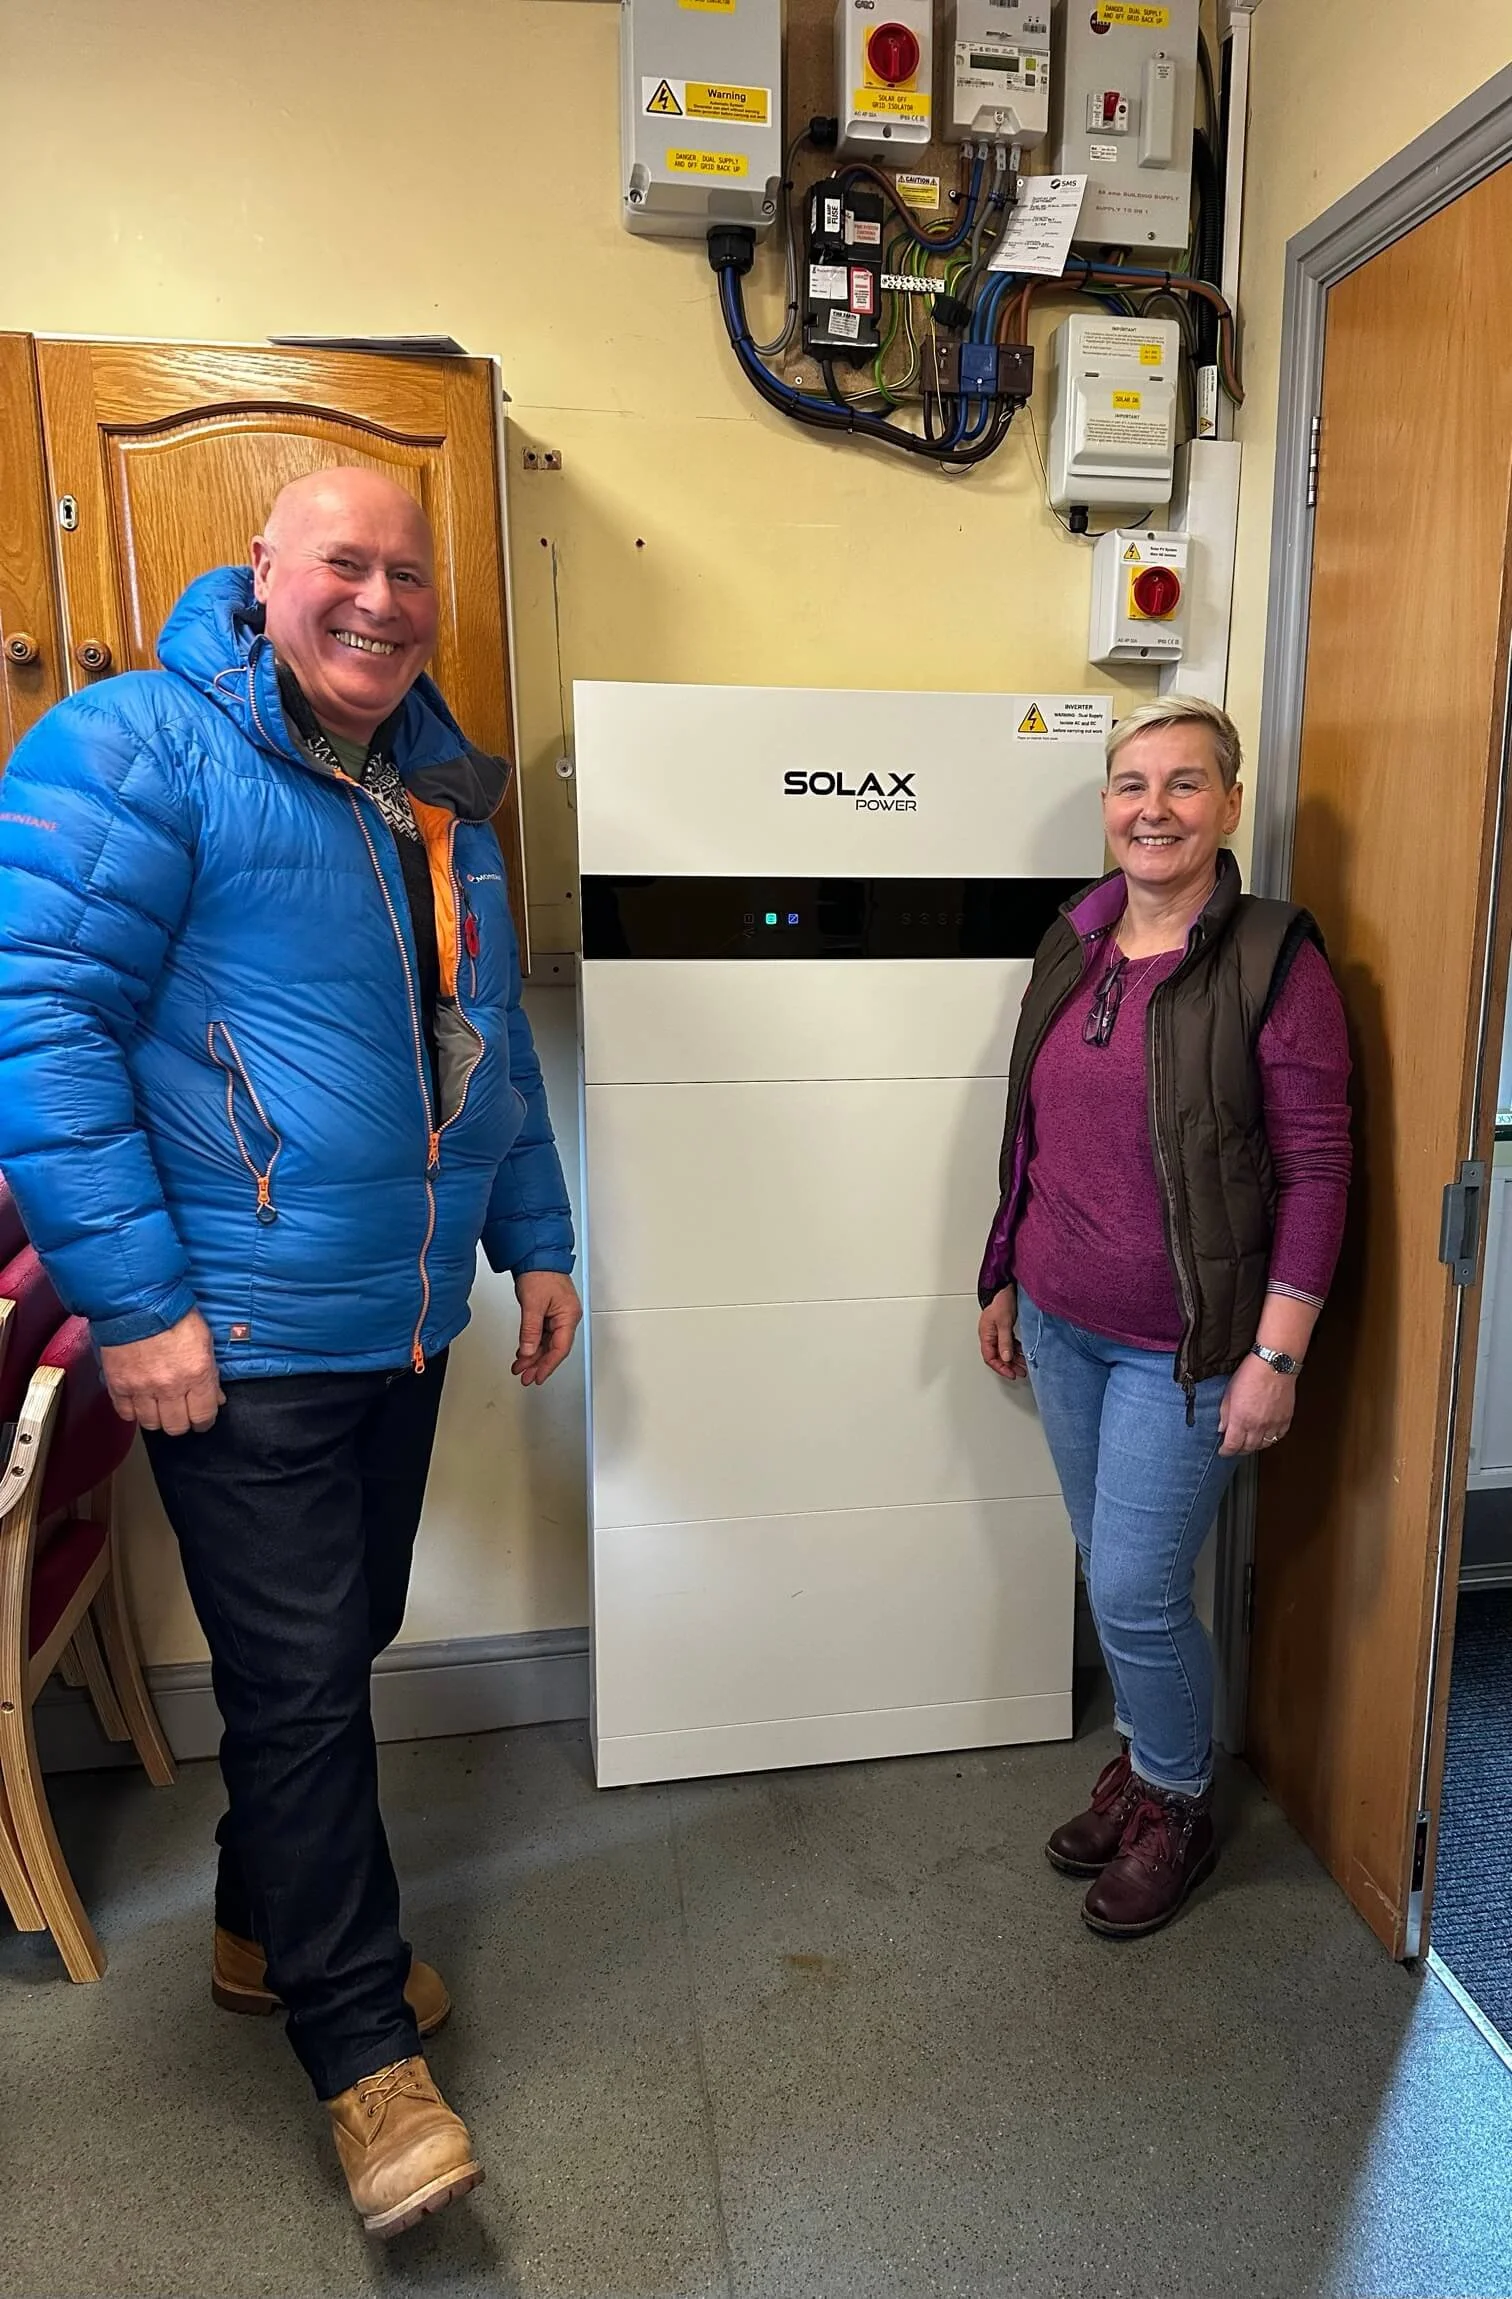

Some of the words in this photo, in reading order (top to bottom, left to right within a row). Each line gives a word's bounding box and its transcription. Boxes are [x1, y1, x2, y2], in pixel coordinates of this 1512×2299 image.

[1144, 9, 1161, 17] SUPPLY
[708, 88, 746, 103] Warning
[897, 95, 907, 103] OFF
[872, 101, 885, 109] GRID
[888, 102, 914, 111] ISOLATOR
[674, 160, 685, 168] AND
[700, 162, 714, 170] GRID
[702, 155, 715, 163] DUAL
[718, 156, 739, 165] SUPPLY
[905, 176, 930, 184] CAUTION
[1061, 179, 1077, 187] SMS
[1123, 191, 1152, 199] BUILDING
[1154, 193, 1180, 201] SUPPLY
[783, 771, 916, 796] SOLAX
[855, 799, 917, 811] POWER
